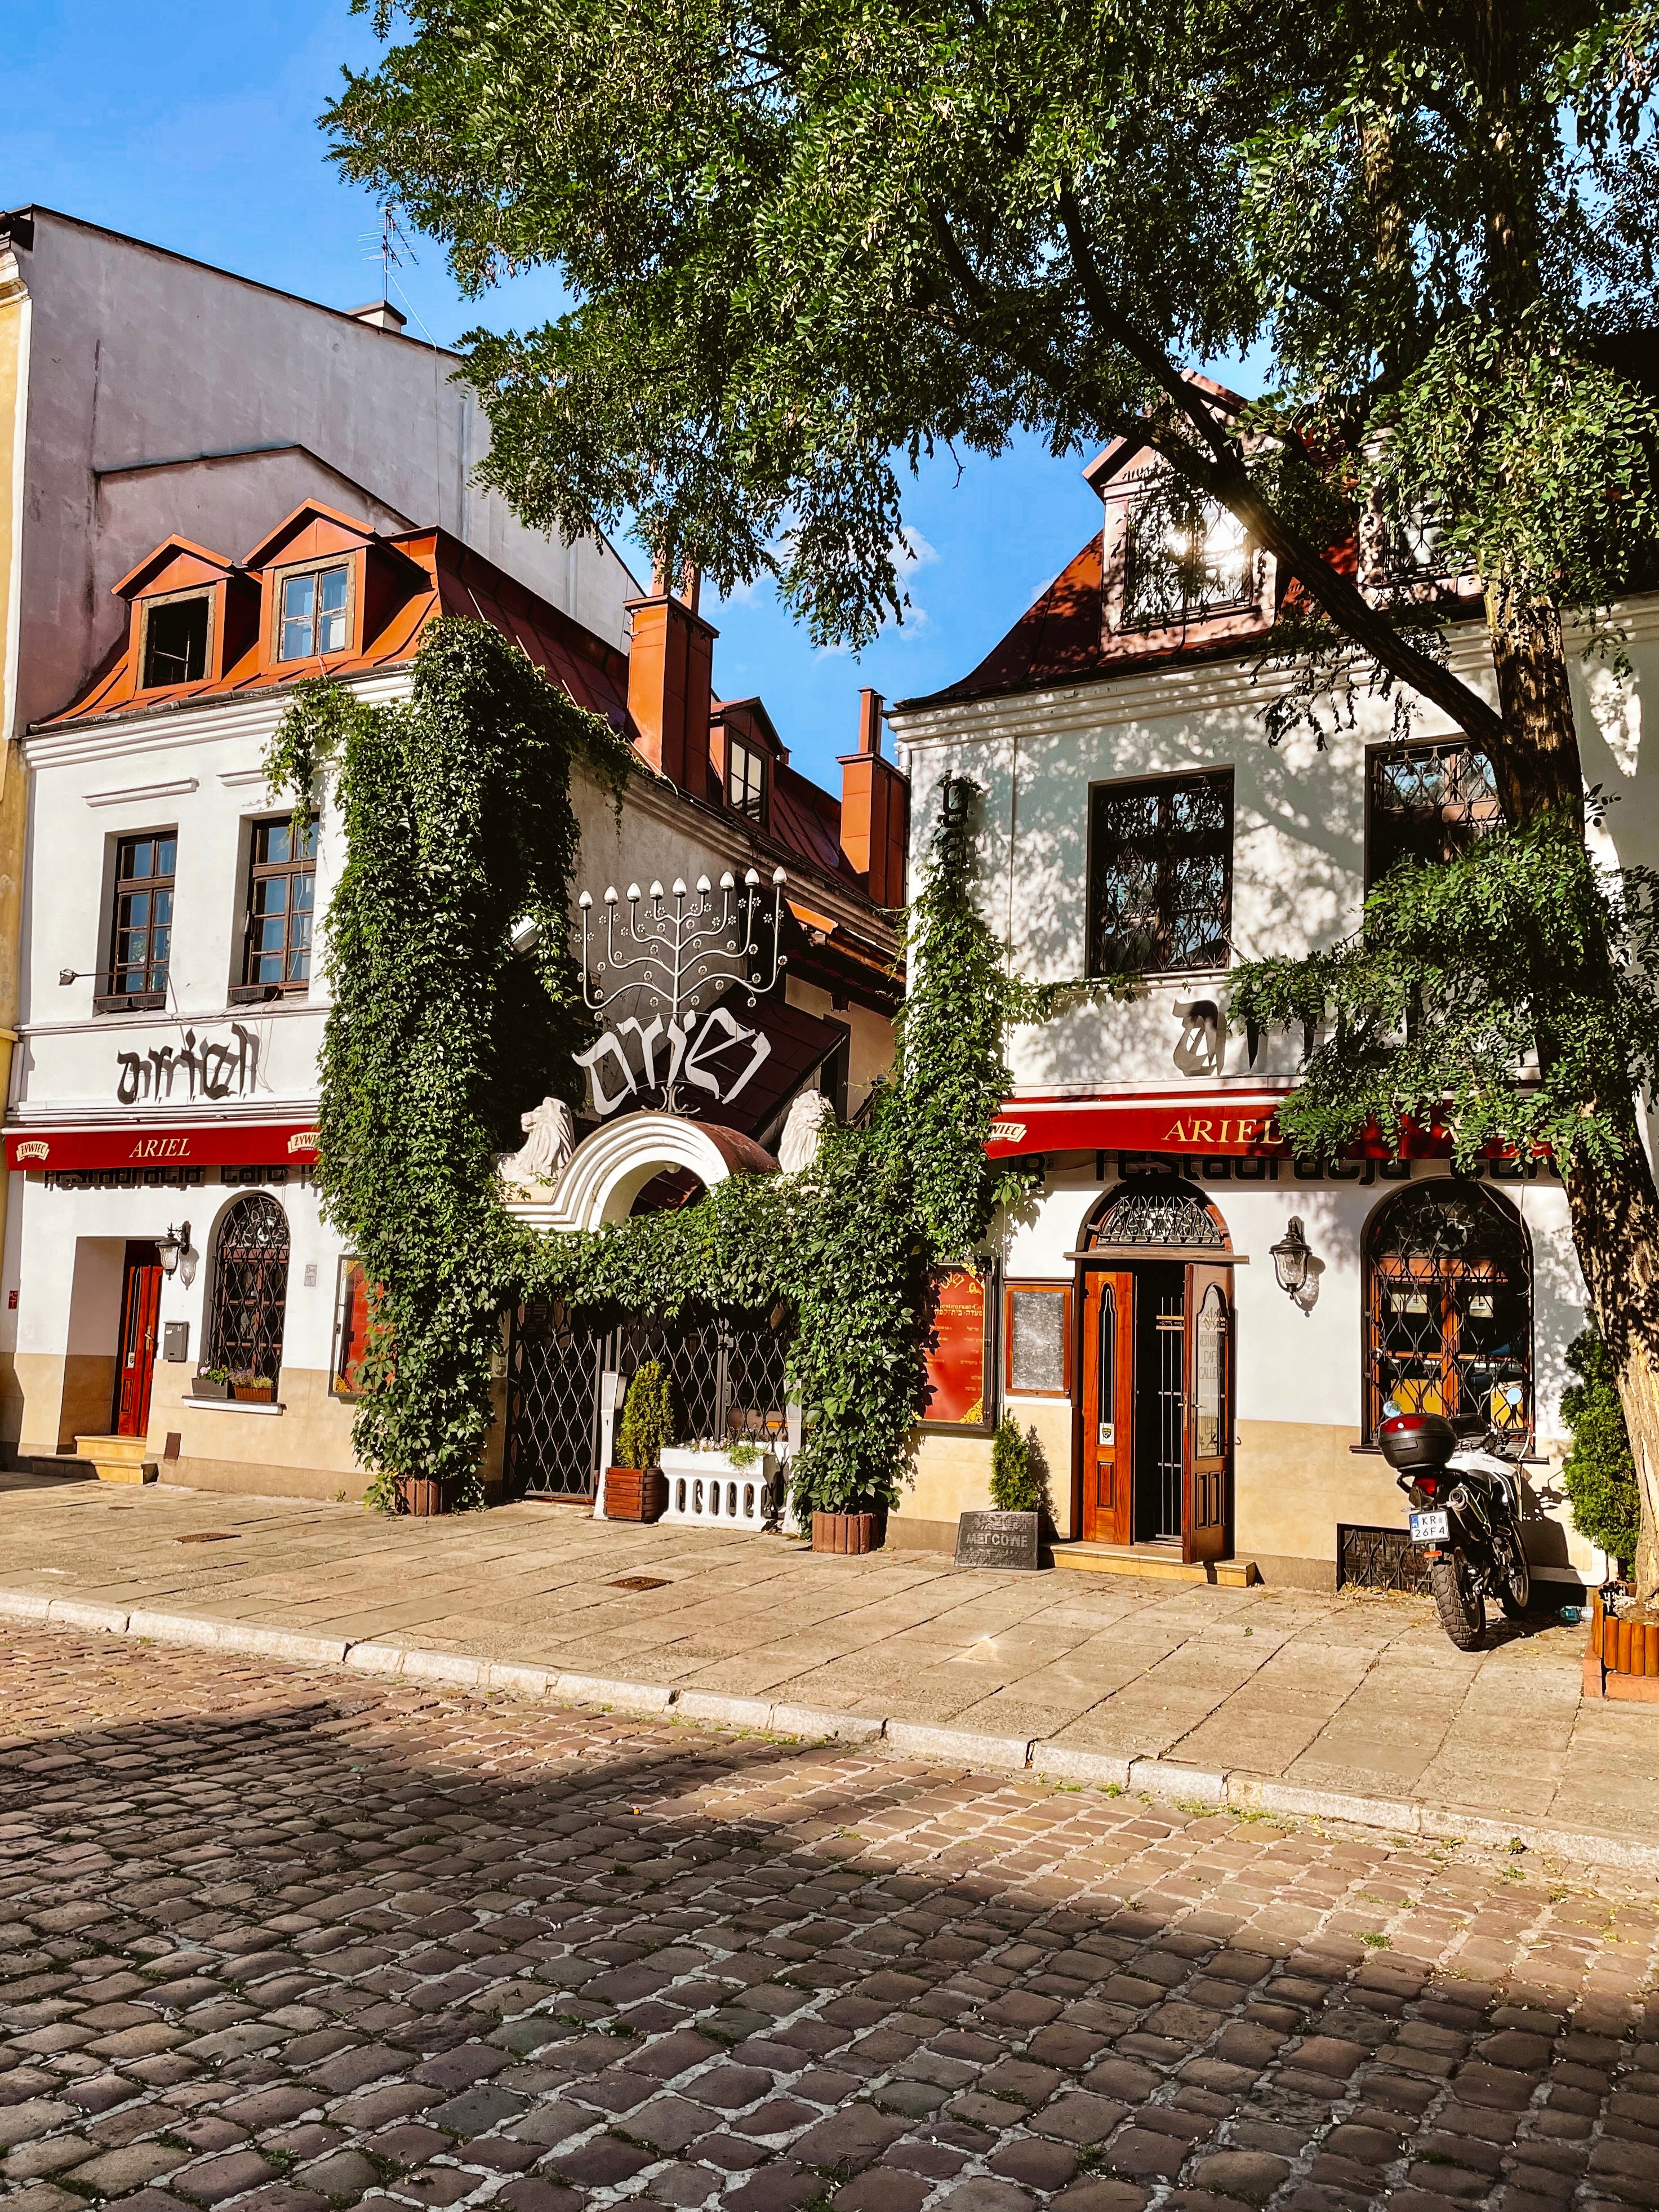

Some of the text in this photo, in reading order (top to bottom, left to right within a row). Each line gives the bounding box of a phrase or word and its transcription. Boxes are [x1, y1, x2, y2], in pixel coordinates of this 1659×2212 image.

[992, 1124, 1021, 1136] WIEC
[1161, 1120, 1284, 1144] ARIEL
[20, 1143, 46, 1154] ŻYWIEC
[128, 1138, 191, 1158] ARIEL
[1422, 1516, 1436, 1525] KR
